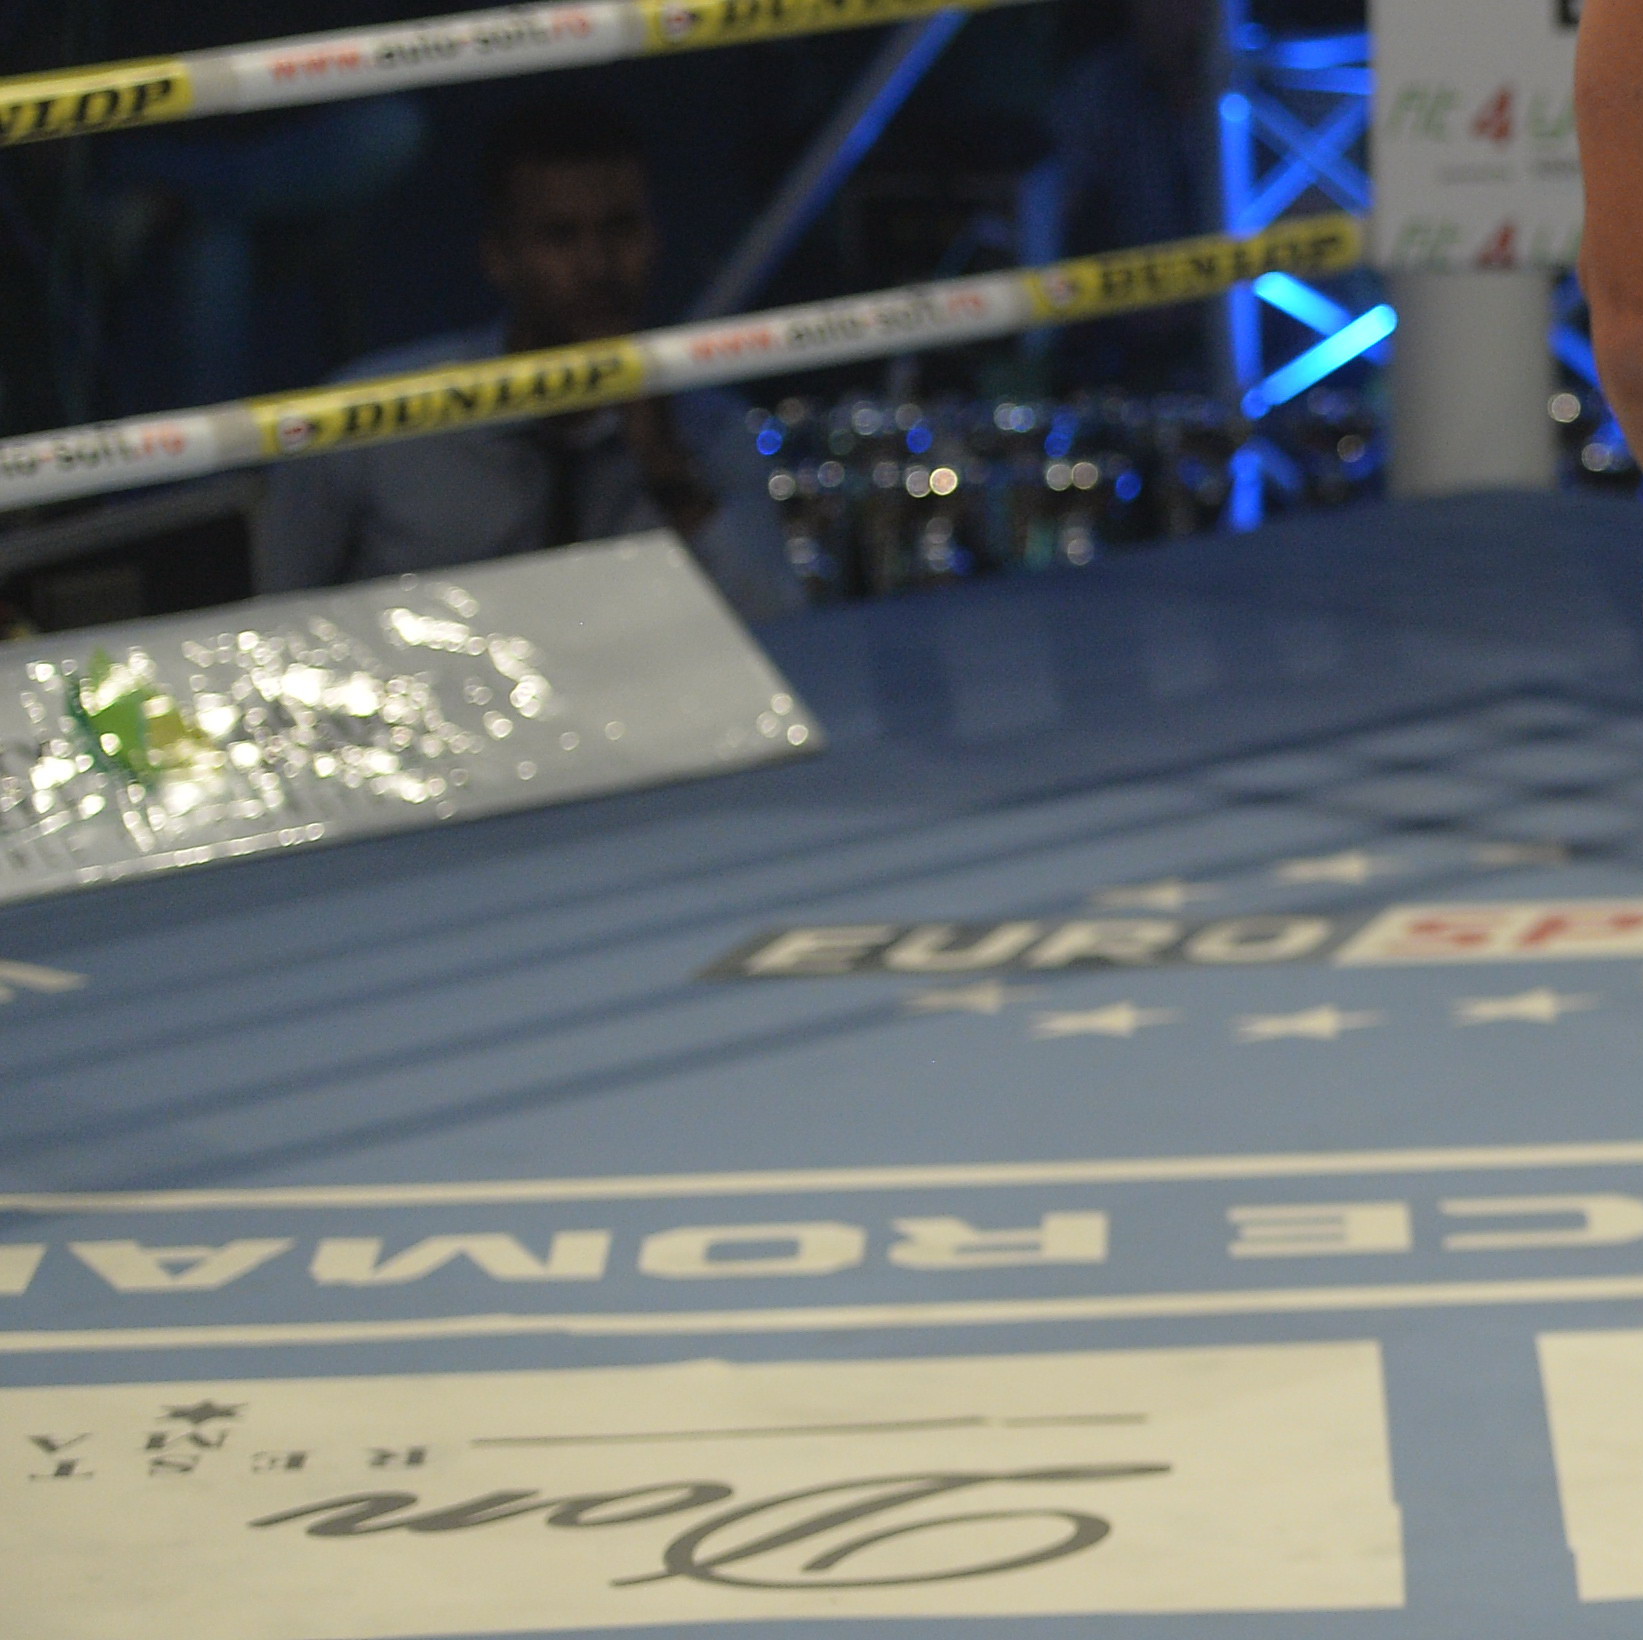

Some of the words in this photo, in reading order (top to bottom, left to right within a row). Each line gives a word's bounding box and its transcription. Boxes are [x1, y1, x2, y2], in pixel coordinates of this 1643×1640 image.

[343, 357, 624, 436] DUNLOP
[0, 1210, 1109, 1298] ROMA
[249, 1463, 1173, 1590] Don
